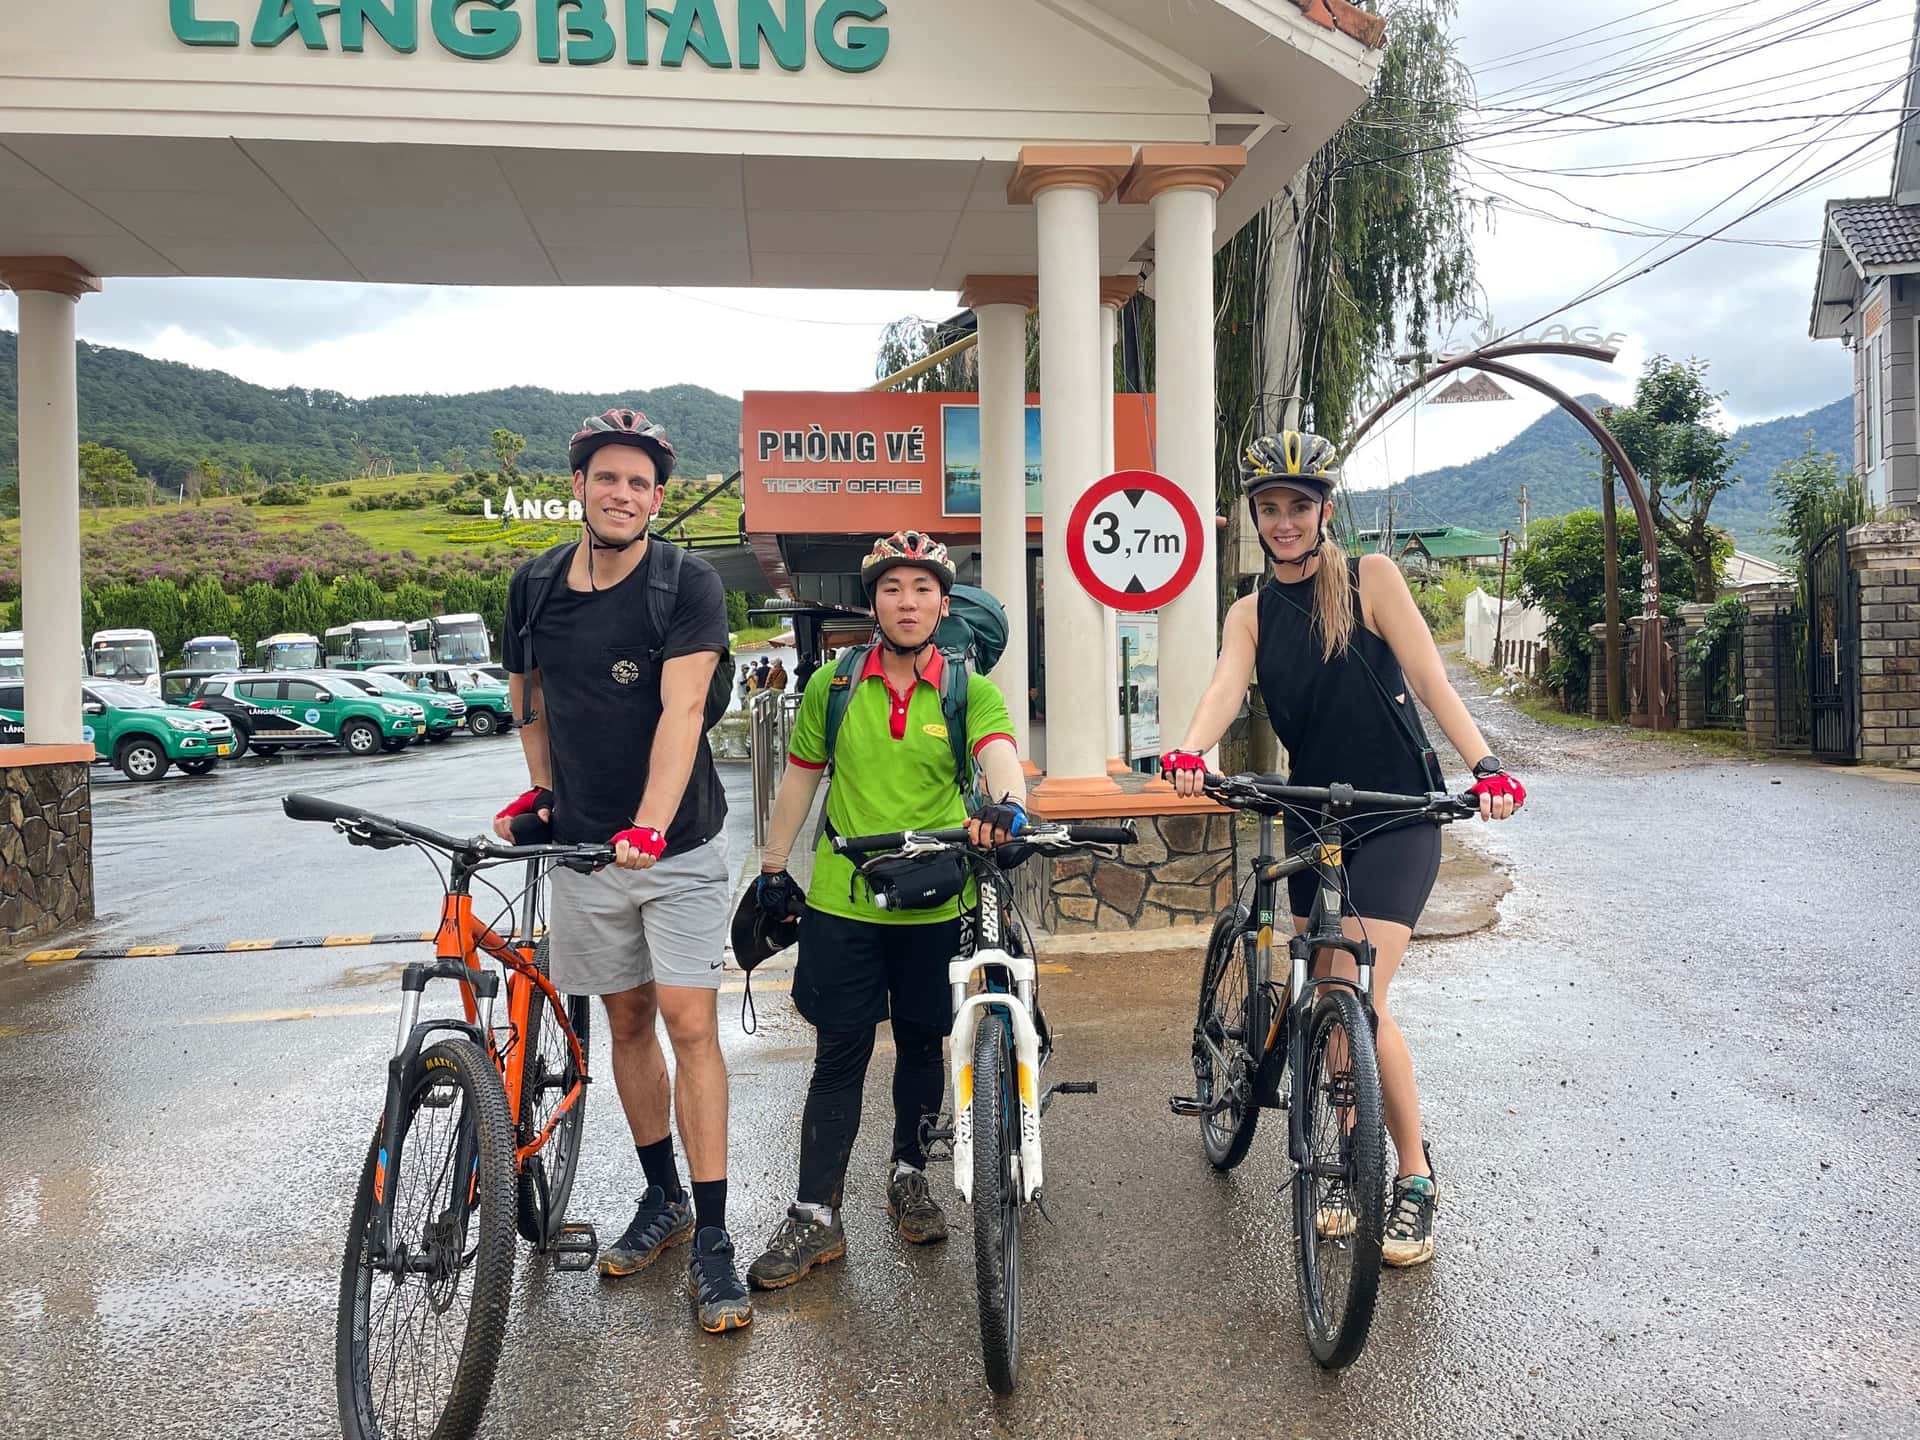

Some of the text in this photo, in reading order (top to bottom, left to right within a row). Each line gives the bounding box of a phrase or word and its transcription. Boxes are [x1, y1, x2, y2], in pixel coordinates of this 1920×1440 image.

[758, 424, 926, 463] PHÒNG VÉ
[762, 478, 923, 494] TICKET OFFICE
[1092, 511, 1181, 559] 3,7m
